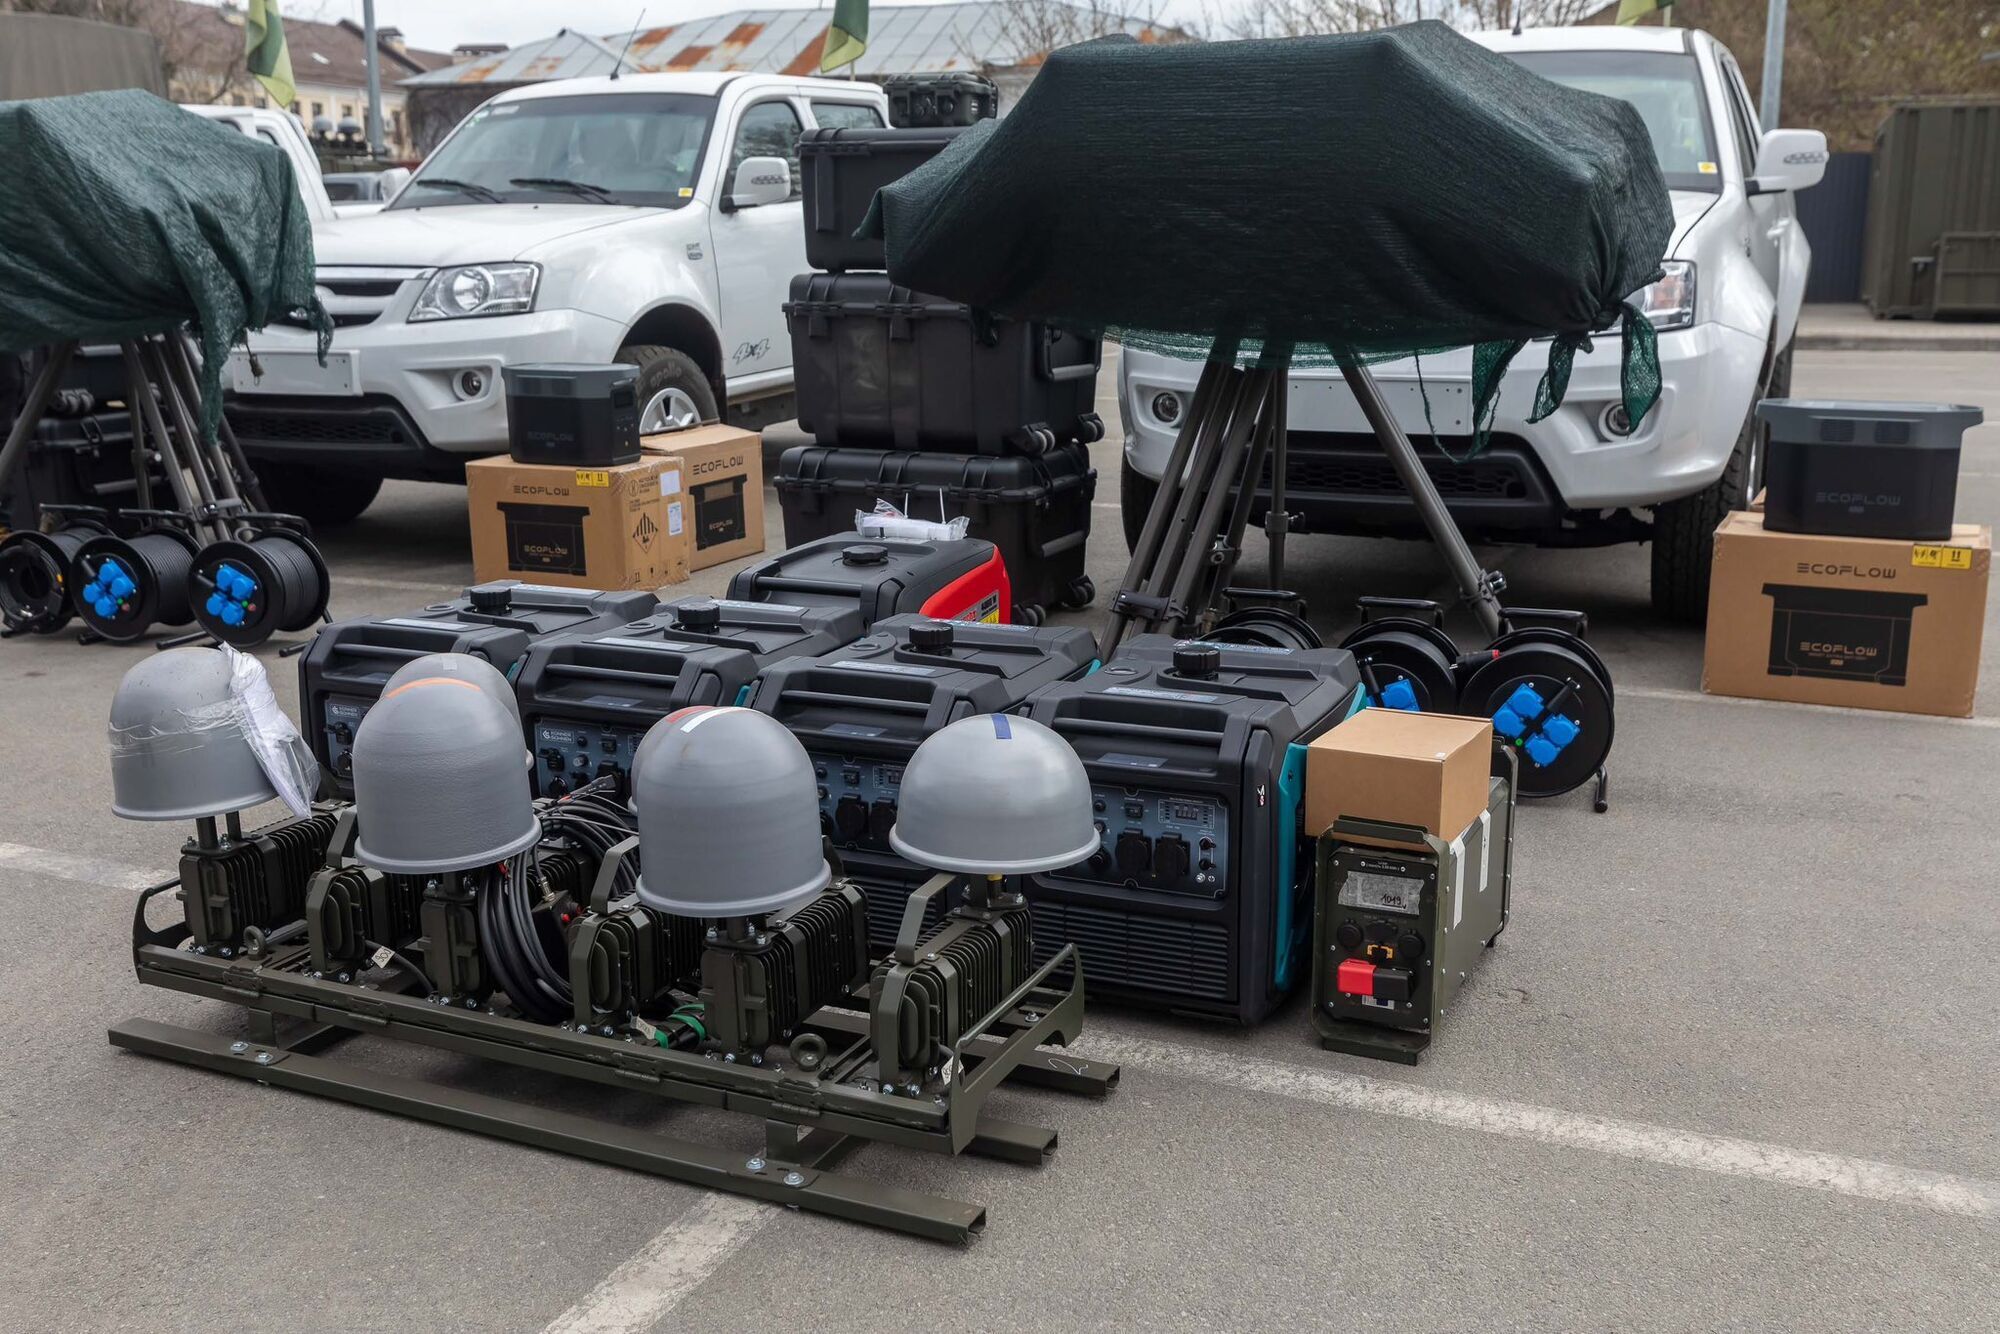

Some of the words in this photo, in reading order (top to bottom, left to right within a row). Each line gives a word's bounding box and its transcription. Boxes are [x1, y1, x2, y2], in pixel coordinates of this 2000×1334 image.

[693, 456, 744, 475] ECOFLOW
[513, 485, 570, 496] ECOFLOW
[1815, 492, 1901, 506] ECOFLOW
[523, 544, 568, 555] ECOFLOW
[1797, 562, 1897, 579] ECOFLOW
[1800, 641, 1878, 657] ECOFLOW
[1380, 893, 1402, 906] 1019
